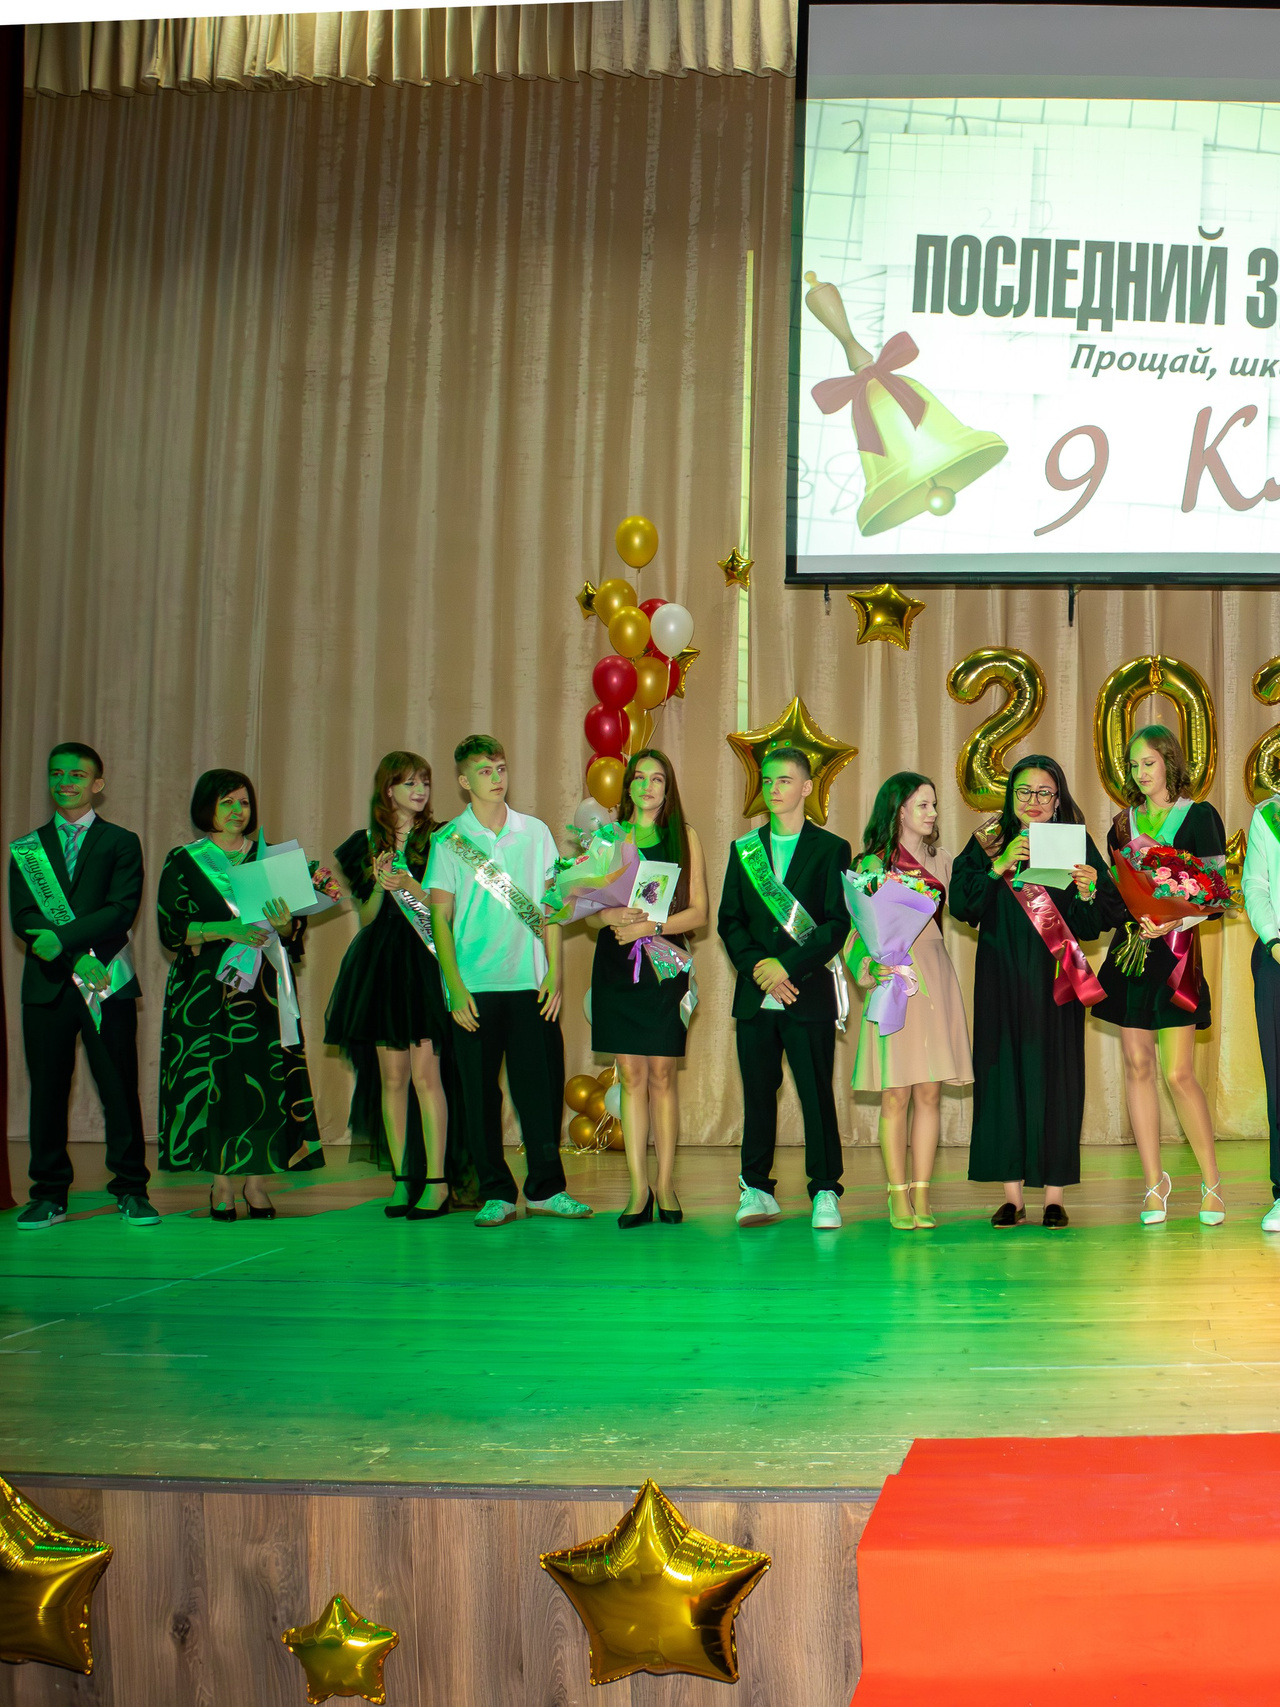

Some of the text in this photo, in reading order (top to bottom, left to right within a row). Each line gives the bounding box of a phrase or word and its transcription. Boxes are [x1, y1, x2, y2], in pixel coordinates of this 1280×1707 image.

[912, 226, 1229, 332] ПОСЛЕДНИЙ
[1070, 343, 1218, 380] Прощай,
[1033, 425, 1110, 537] 9
[1026, 895, 1060, 930] 2025
